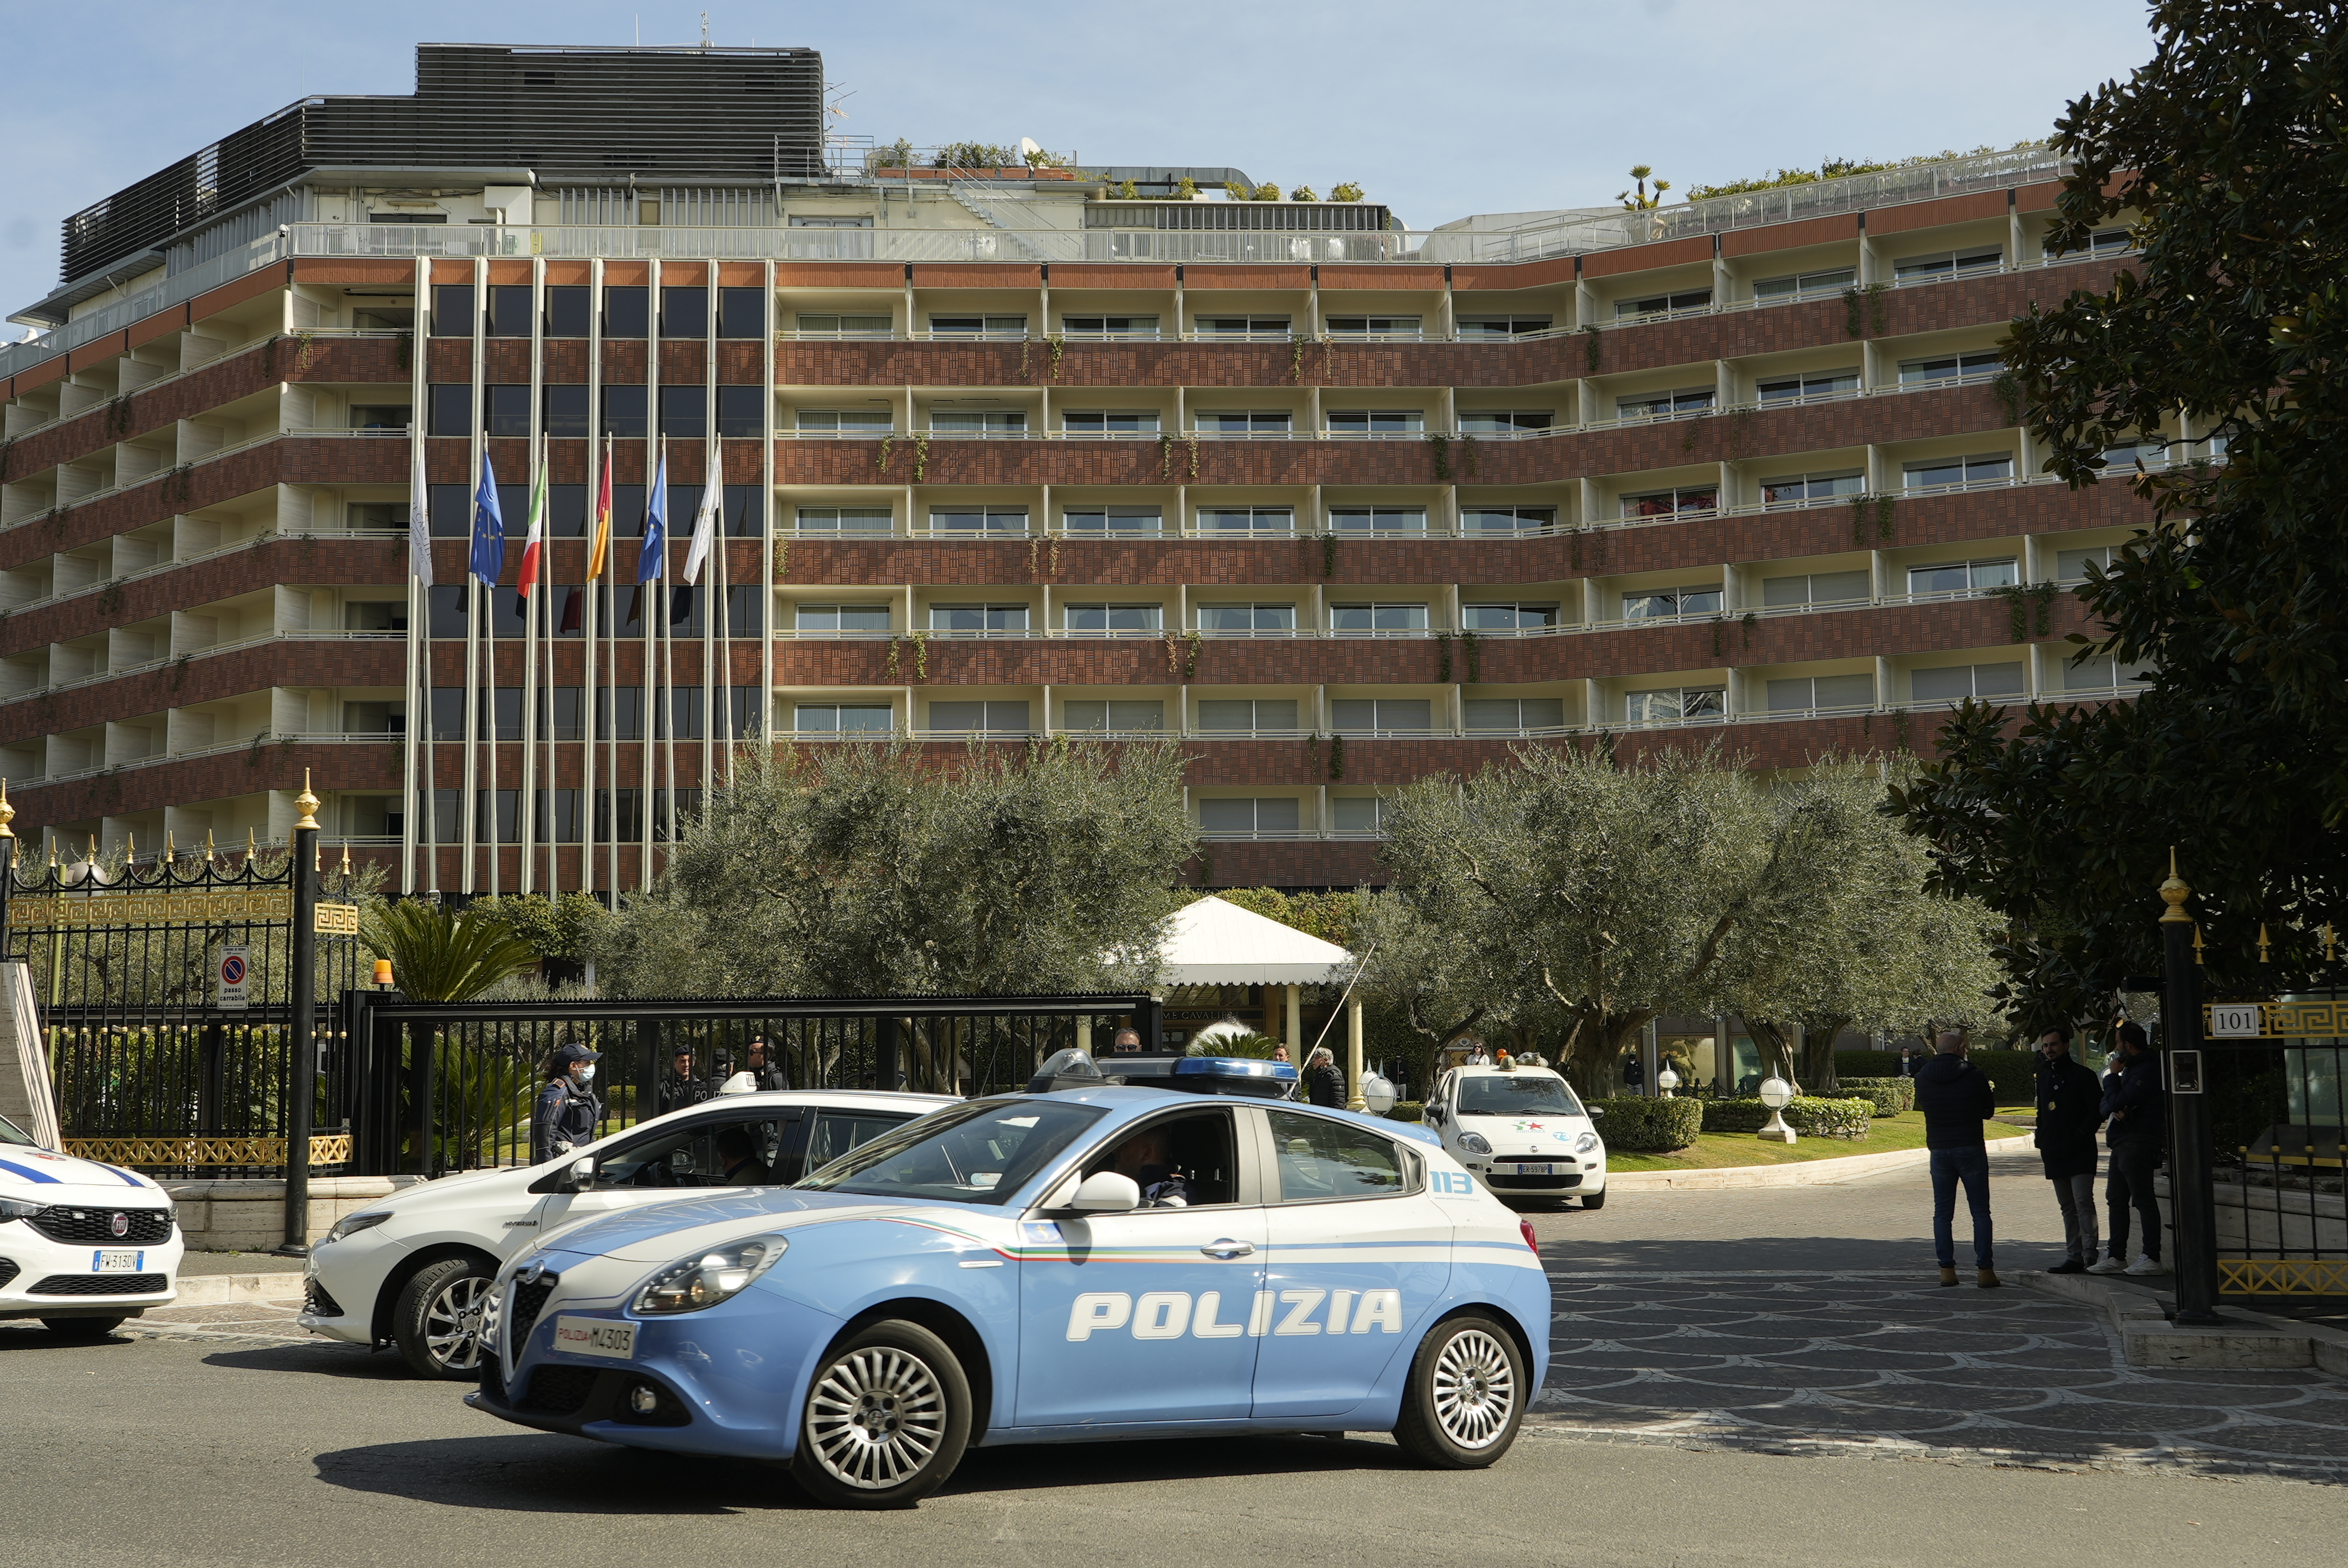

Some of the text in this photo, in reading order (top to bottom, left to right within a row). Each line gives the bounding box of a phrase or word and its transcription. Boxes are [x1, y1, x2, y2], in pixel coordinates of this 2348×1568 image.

[2218, 1013, 2252, 1029] 101
[1429, 1171, 1473, 1194] 113
[116, 1220, 126, 1230] FIAT
[1065, 1289, 1403, 1342] POLIZIA
[558, 1328, 589, 1341] POLIZIA
